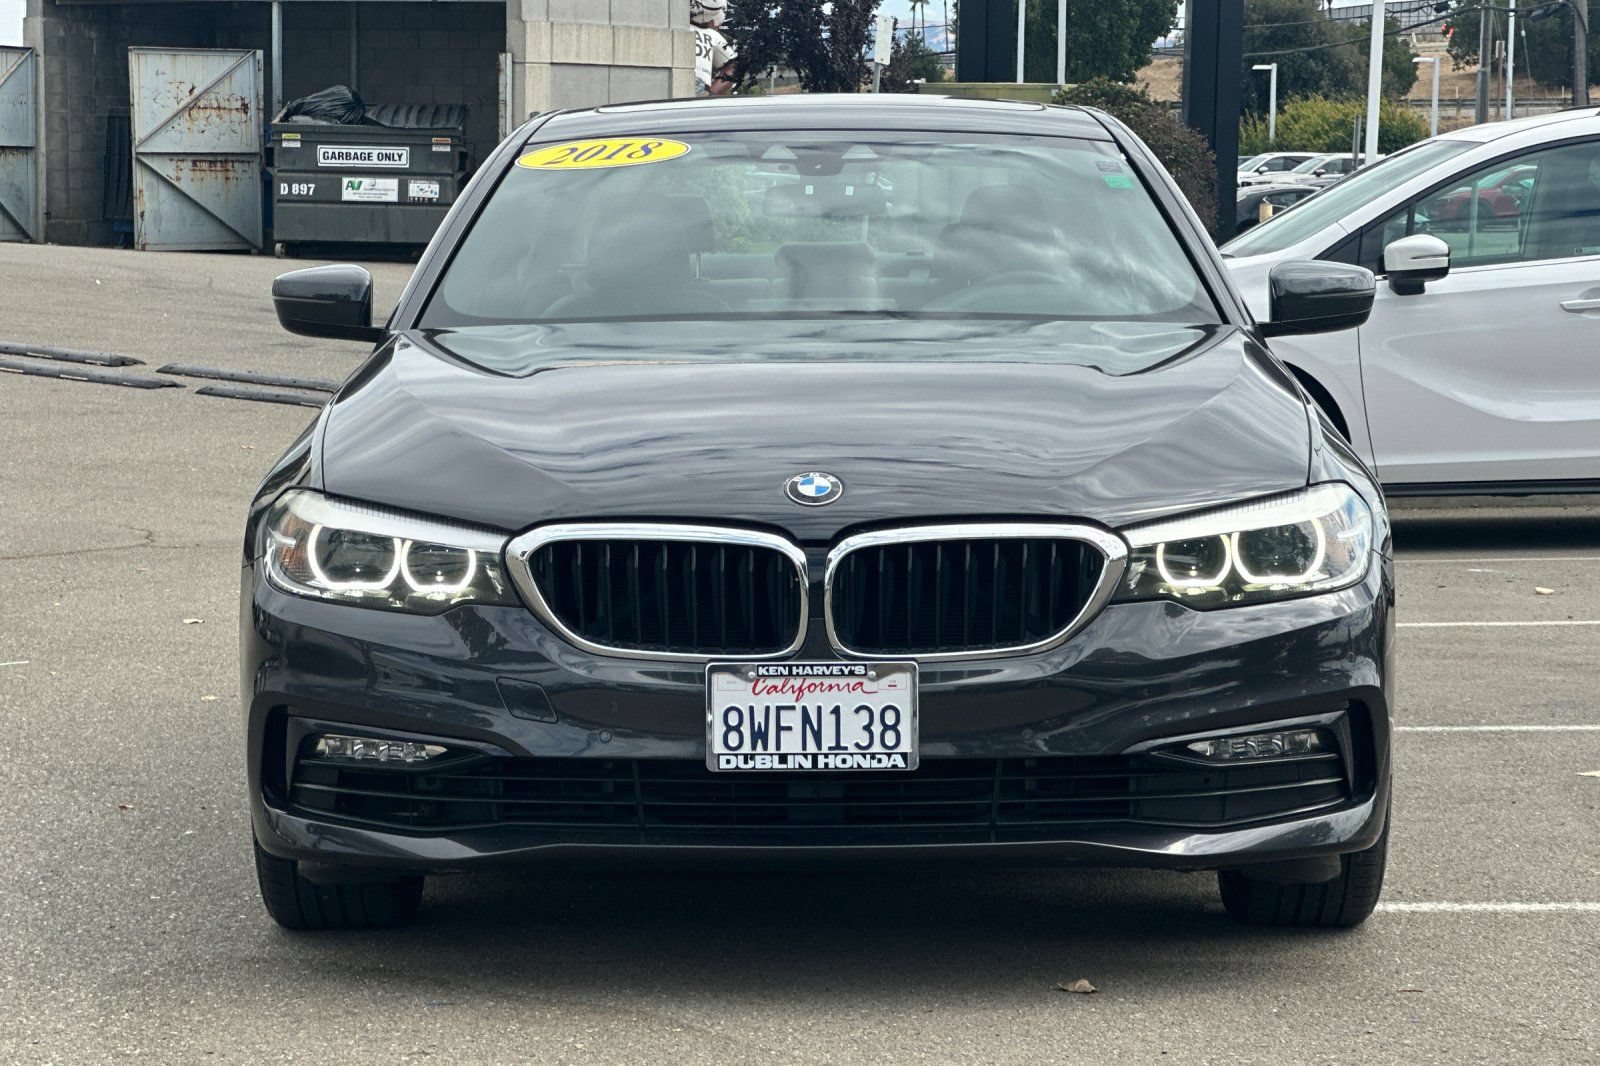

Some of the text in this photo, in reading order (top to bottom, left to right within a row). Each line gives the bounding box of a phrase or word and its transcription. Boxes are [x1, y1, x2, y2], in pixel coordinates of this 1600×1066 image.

[322, 151, 404, 163] GARBAGE ONLY
[542, 142, 663, 166] 2018
[280, 183, 316, 196] D 897
[758, 665, 866, 676] KEN HARVEY'S
[752, 678, 878, 702] California
[722, 704, 902, 751] 8WFN138
[719, 754, 906, 769] DUBLIN HONDA
